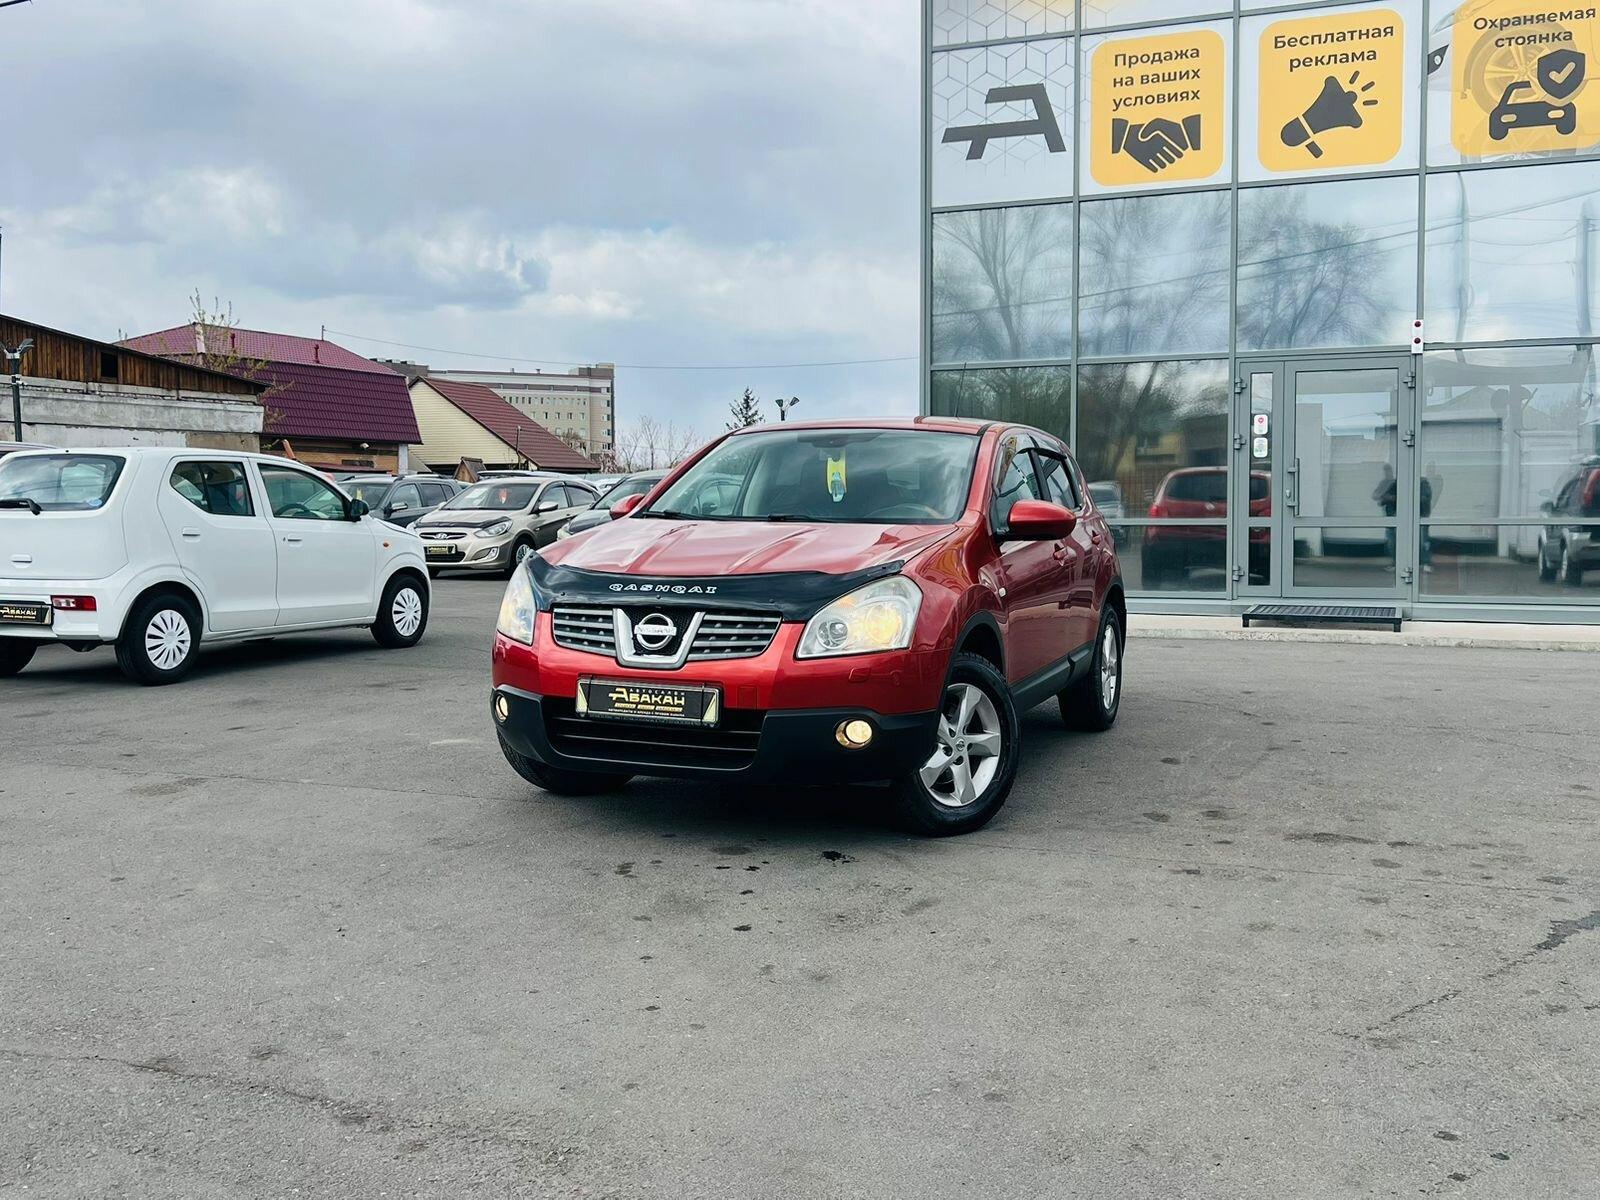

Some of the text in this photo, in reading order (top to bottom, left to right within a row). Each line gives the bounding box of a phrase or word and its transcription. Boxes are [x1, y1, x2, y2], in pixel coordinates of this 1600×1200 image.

[1473, 8, 1597, 31] Охраняемая
[1273, 25, 1395, 49] Бесплатная
[1494, 30, 1574, 48] стоянка
[1114, 47, 1201, 69] Продажа
[1289, 49, 1378, 72] реклама
[1113, 68, 1201, 88] на ваших
[1112, 89, 1201, 112] условиях
[608, 583, 718, 594] QASHQAI
